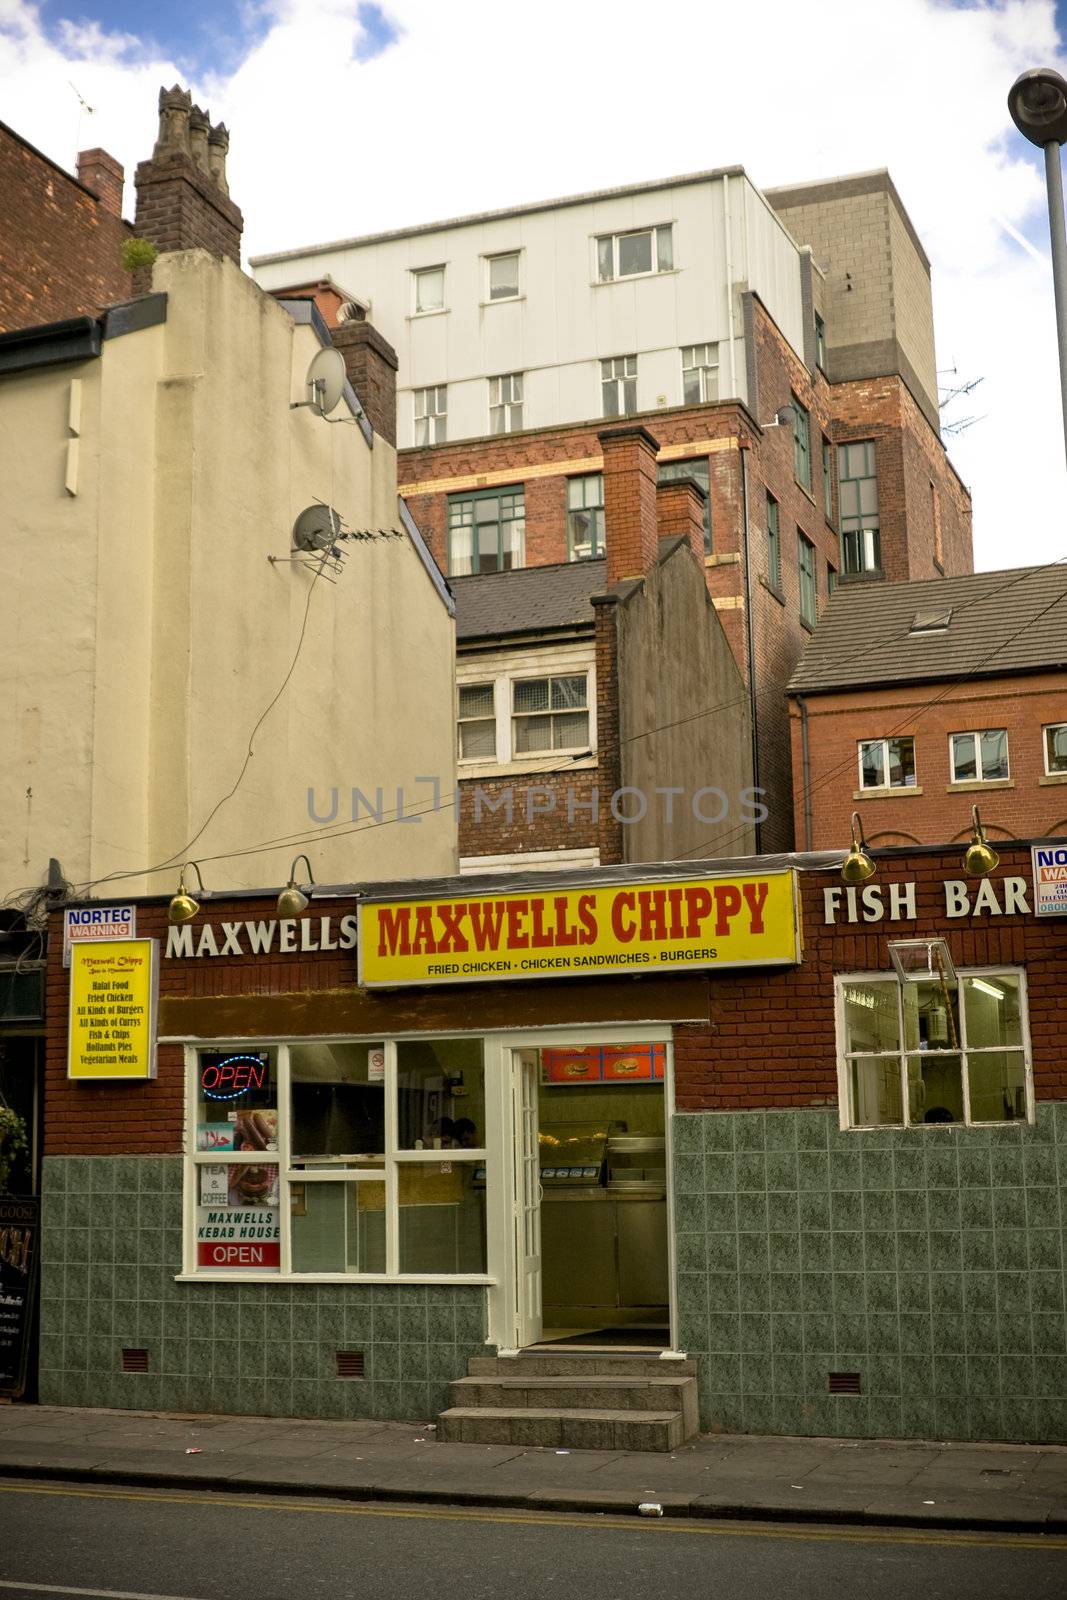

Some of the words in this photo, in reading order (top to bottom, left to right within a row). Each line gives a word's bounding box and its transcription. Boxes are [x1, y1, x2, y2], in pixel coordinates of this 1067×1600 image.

[823, 882, 917, 924] FISH
[943, 876, 1032, 918] BAR
[69, 908, 131, 925] NORTEC
[378, 895, 597, 957] MAXWELLS
[611, 882, 769, 943] CHIPPY
[72, 924, 128, 938] WARNING
[164, 915, 357, 958] MAXWELLS
[428, 963, 460, 975] FRIED
[462, 960, 511, 972] CHICKEN
[520, 957, 571, 970] CHICKEN
[573, 952, 650, 966] SANDWICHES
[660, 948, 718, 962] BURGERS
[112, 981, 128, 990] Food
[88, 994, 104, 1002] Fried
[107, 993, 133, 1002] Chicken
[77, 1006, 86, 1015] All
[88, 1006, 106, 1014] Kinds
[108, 1006, 114, 1014] of
[117, 1005, 144, 1015] Burgers
[79, 1018, 88, 1027] All
[90, 1018, 109, 1027] Kinds
[110, 1018, 117, 1026] of
[89, 1030, 102, 1039] Fish
[104, 1030, 110, 1039] &
[112, 1030, 130, 1040] Chips
[118, 1042, 132, 1051] Pies
[80, 1055, 117, 1065] Vegetarian
[118, 1054, 138, 1063] Meals
[202, 1066, 266, 1089] OPEN
[204, 1166, 226, 1175] TEA
[211, 1180, 219, 1189] &
[202, 1192, 227, 1204] COFFEE
[207, 1212, 273, 1224] MAXWELLS
[198, 1227, 235, 1238] KEBAB
[239, 1227, 280, 1238] HOUSE
[213, 1246, 263, 1263] OPEN
